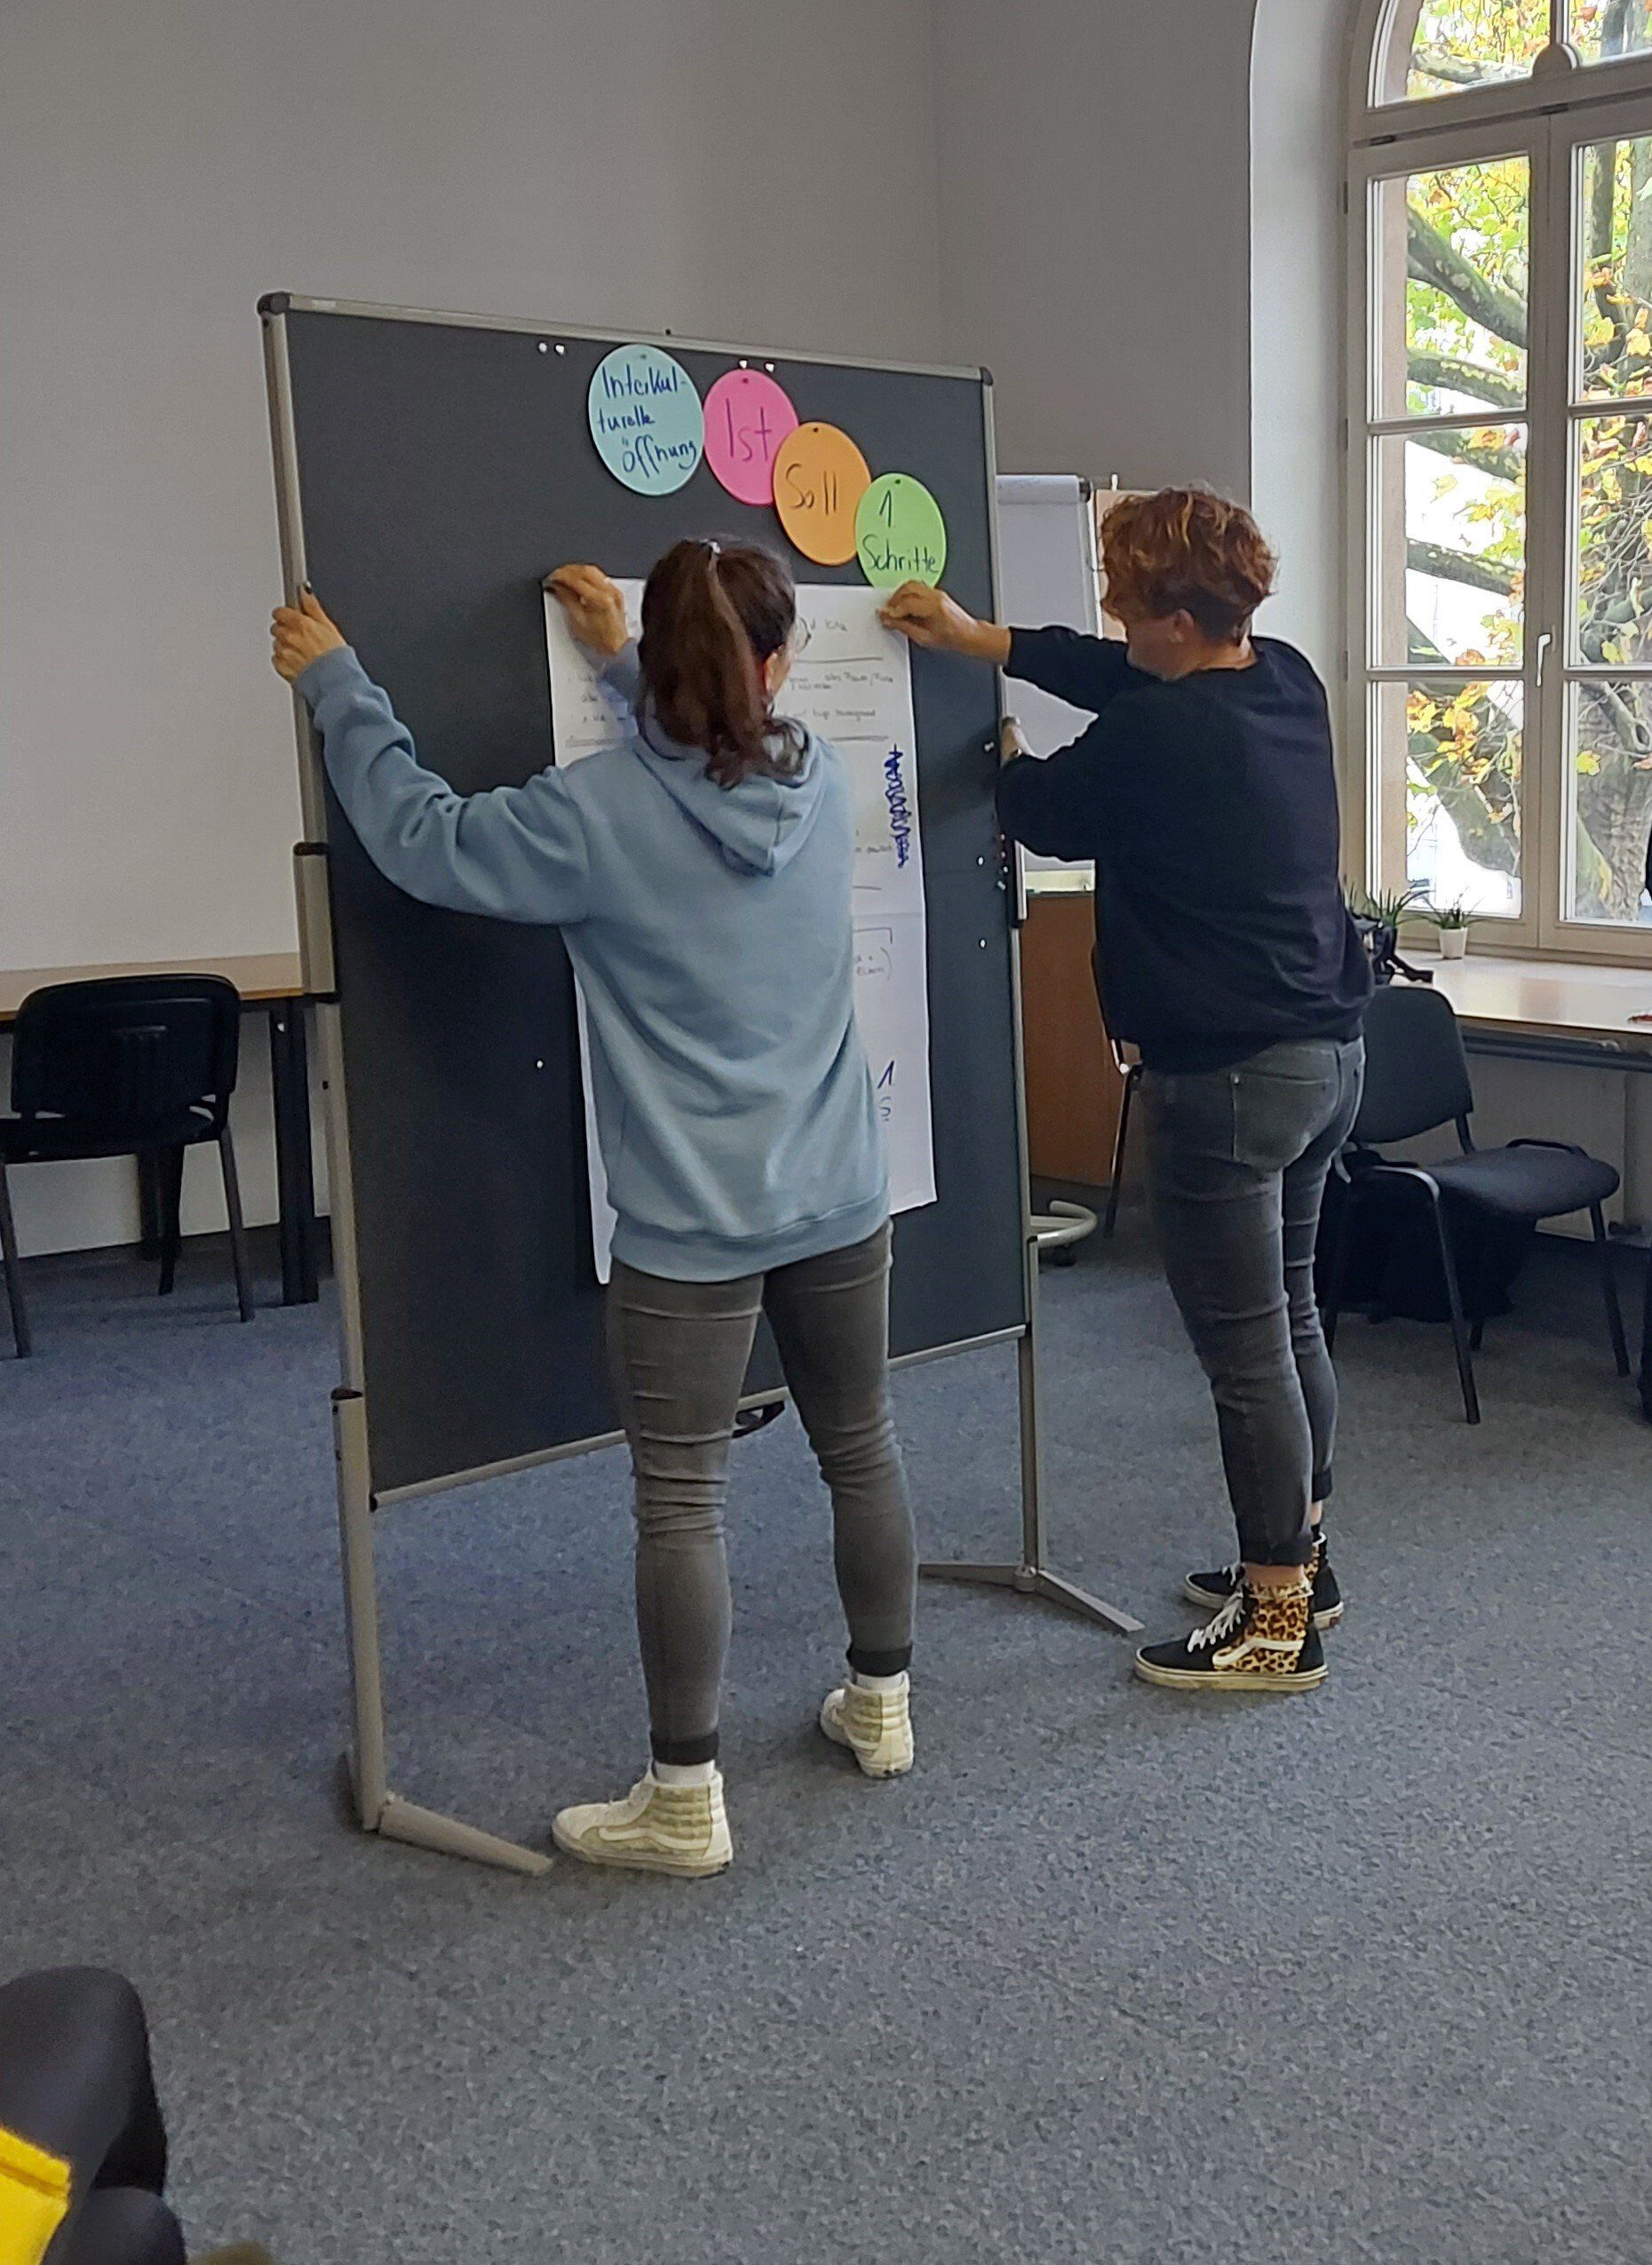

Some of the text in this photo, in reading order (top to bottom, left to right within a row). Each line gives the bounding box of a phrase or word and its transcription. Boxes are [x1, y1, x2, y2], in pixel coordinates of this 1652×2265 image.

[726, 397, 772, 462] Ist
[786, 462, 838, 516] Soll
[862, 533, 941, 573] Schritte
